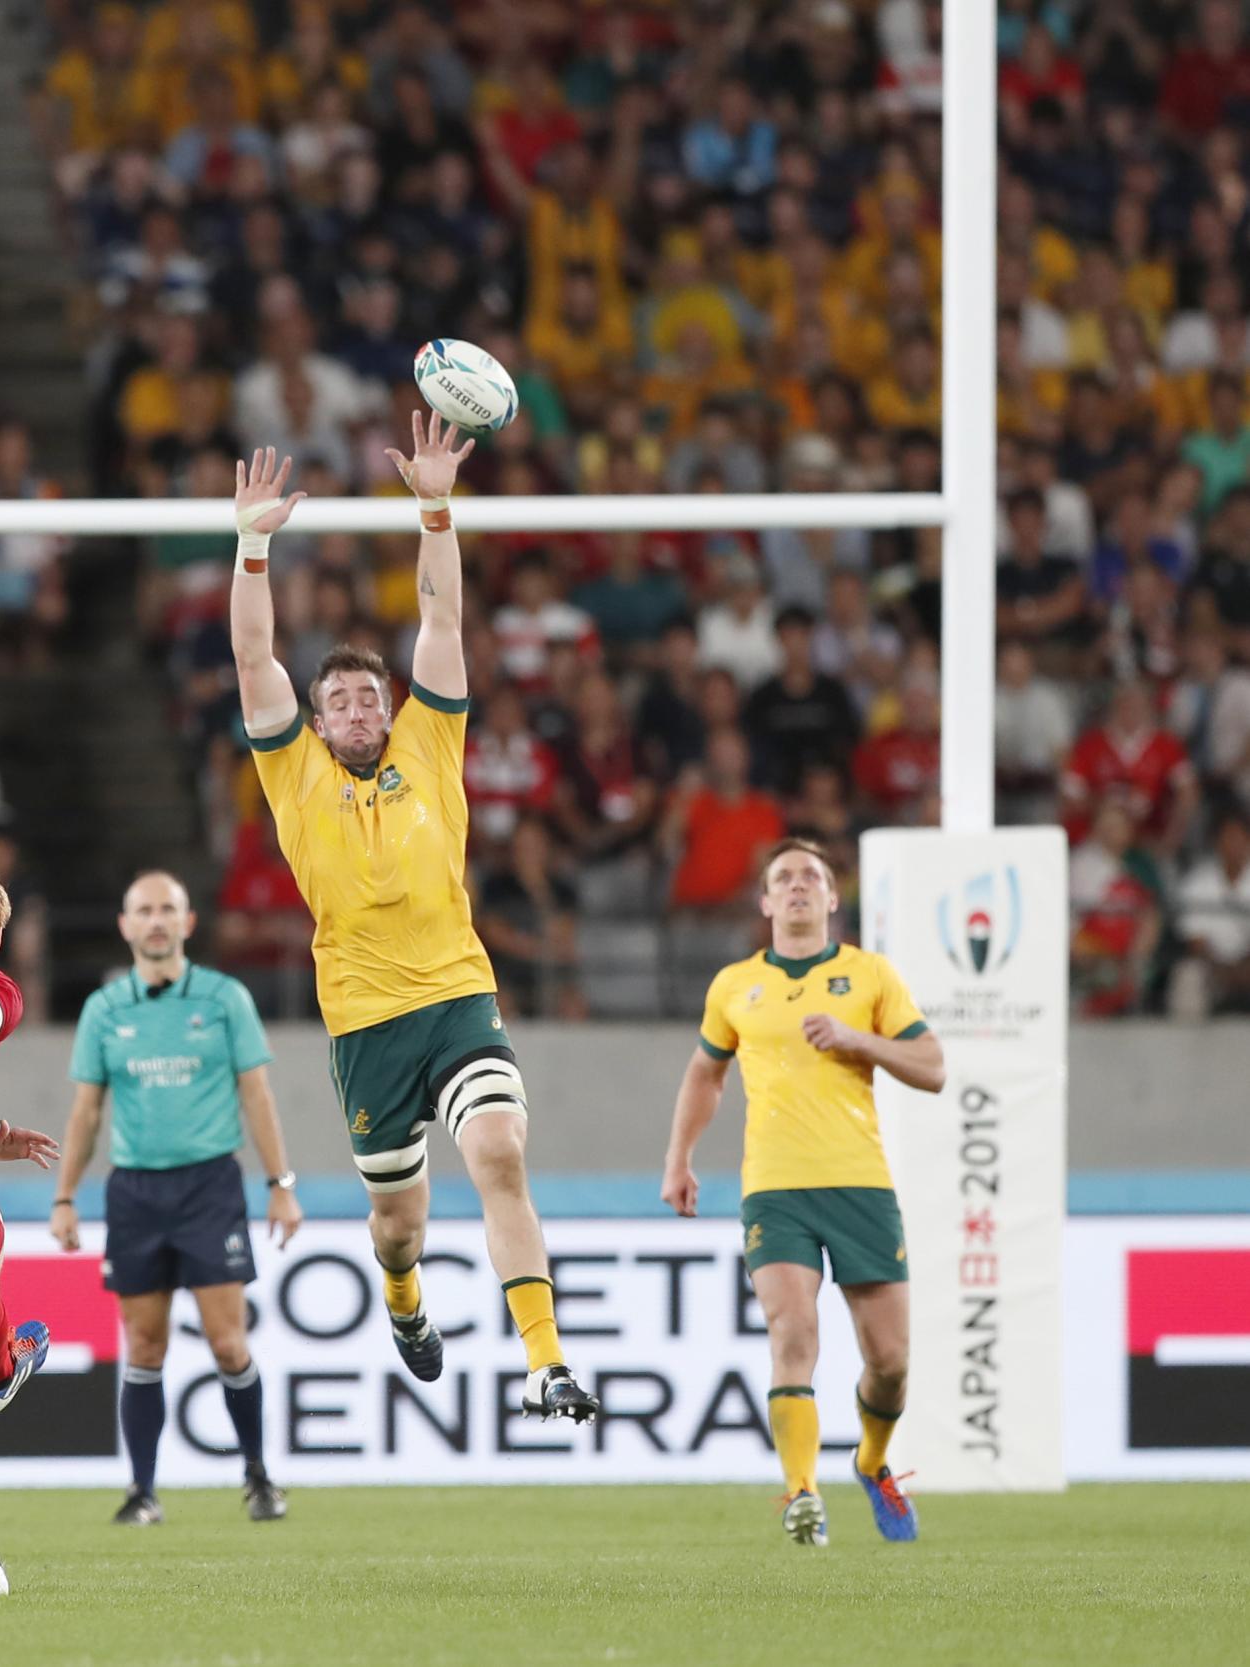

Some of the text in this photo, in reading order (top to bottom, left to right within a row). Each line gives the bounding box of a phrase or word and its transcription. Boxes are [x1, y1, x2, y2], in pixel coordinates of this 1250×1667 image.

[437, 375, 492, 420] GILBERT
[959, 1085, 1000, 1197] 2019
[960, 1206, 999, 1289] 日本
[960, 1295, 1000, 1460] JAPAN
